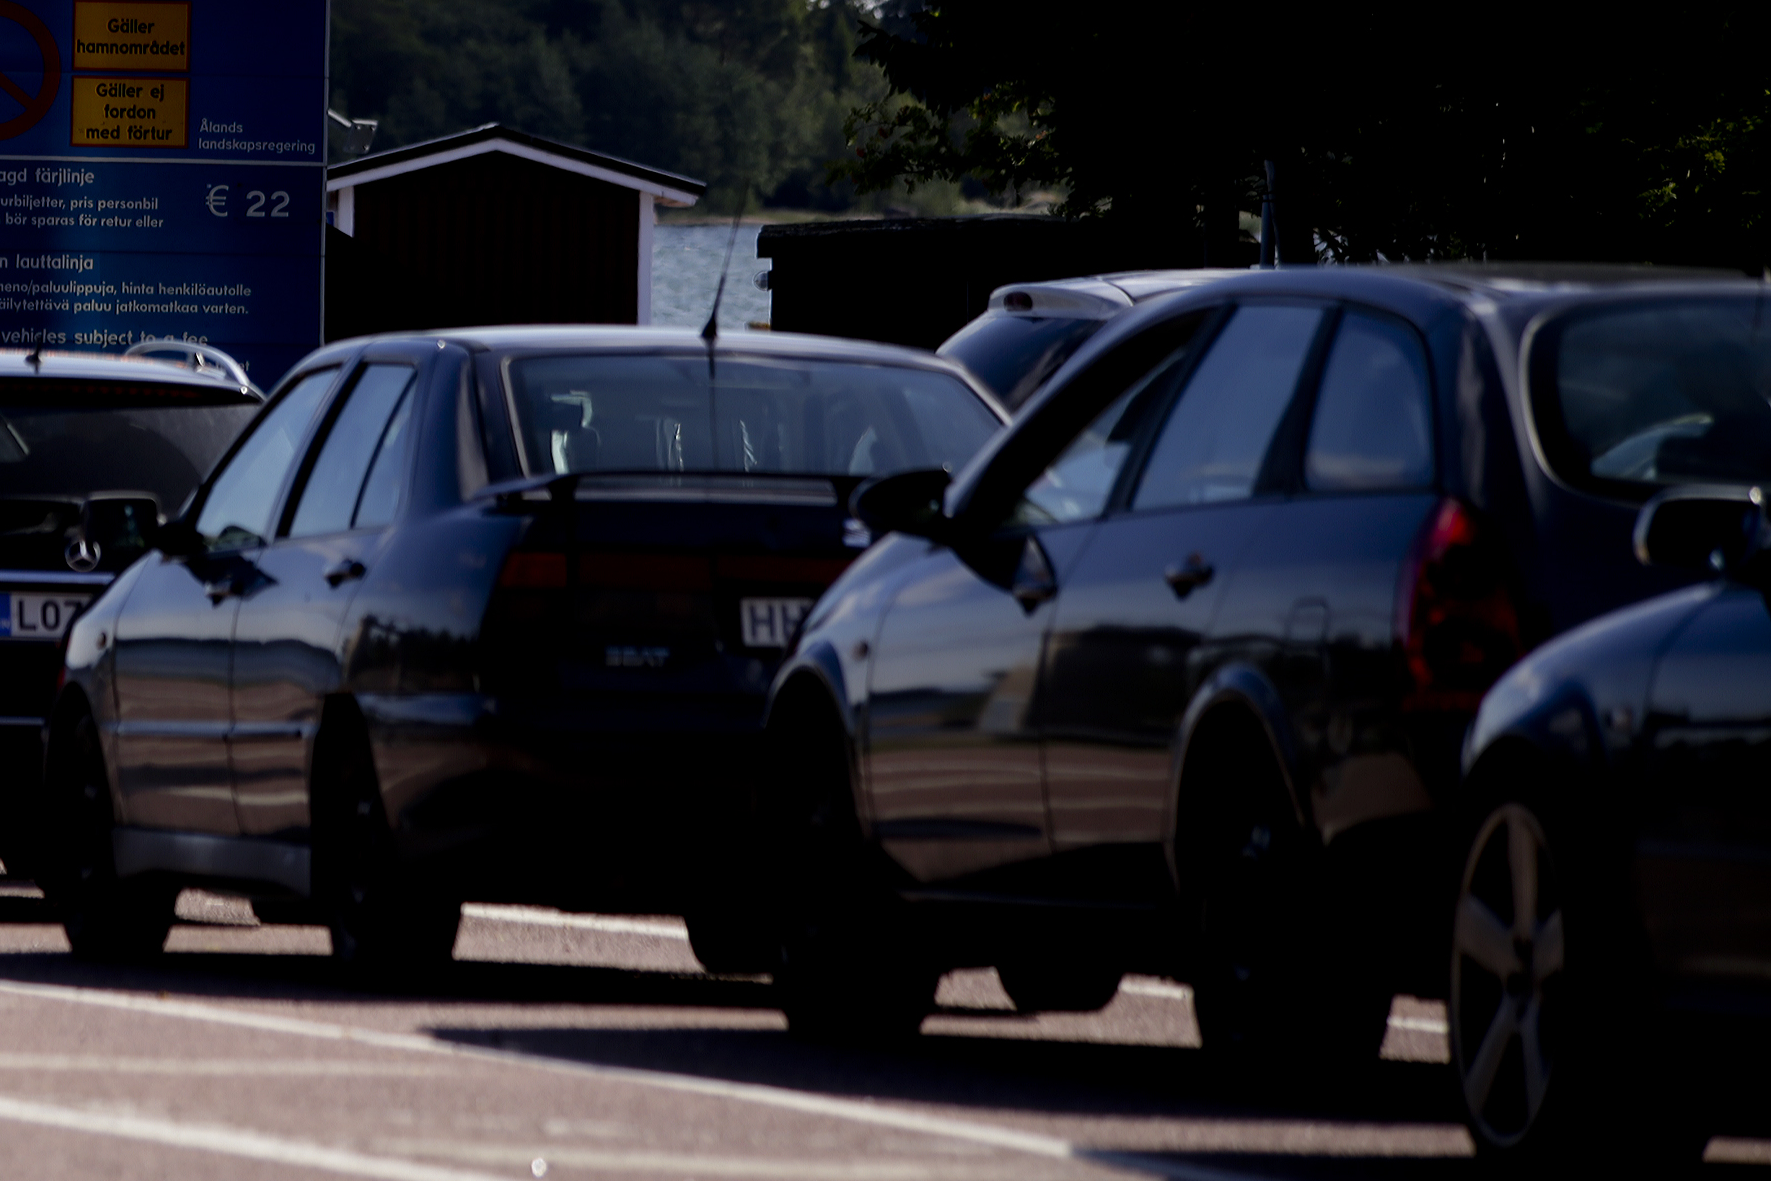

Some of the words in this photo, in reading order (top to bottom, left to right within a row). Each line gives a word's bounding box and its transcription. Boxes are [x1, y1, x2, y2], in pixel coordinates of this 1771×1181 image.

[107, 17, 155, 35] Gäller
[76, 39, 186, 57] hamnområdet
[96, 83, 144, 99] Gäller
[150, 85, 165, 102] ej
[104, 104, 157, 120] fordon
[86, 125, 121, 141] med
[127, 125, 173, 142] förtur
[199, 118, 244, 134] Ålands
[198, 137, 316, 155] landskapsregering
[35, 167, 95, 187] färjlinje
[70, 196, 94, 212] pris
[98, 197, 159, 212] personbil
[206, 185, 229, 218] €
[246, 190, 290, 218] 22
[5, 211, 27, 226] bör
[31, 216, 75, 229] sparas
[78, 214, 98, 228] för
[101, 216, 132, 228] retur
[136, 216, 164, 229] eller
[16, 253, 94, 273] lauttalinja
[121, 281, 155, 296] hinta
[158, 281, 252, 297] henkilöautolle
[73, 299, 112, 314] paluu
[115, 299, 199, 315] jatkomatkaa
[202, 301, 250, 315] varten.
[1, 327, 67, 345] vehicles
[74, 329, 133, 349] subject
[183, 331, 209, 346] fee
